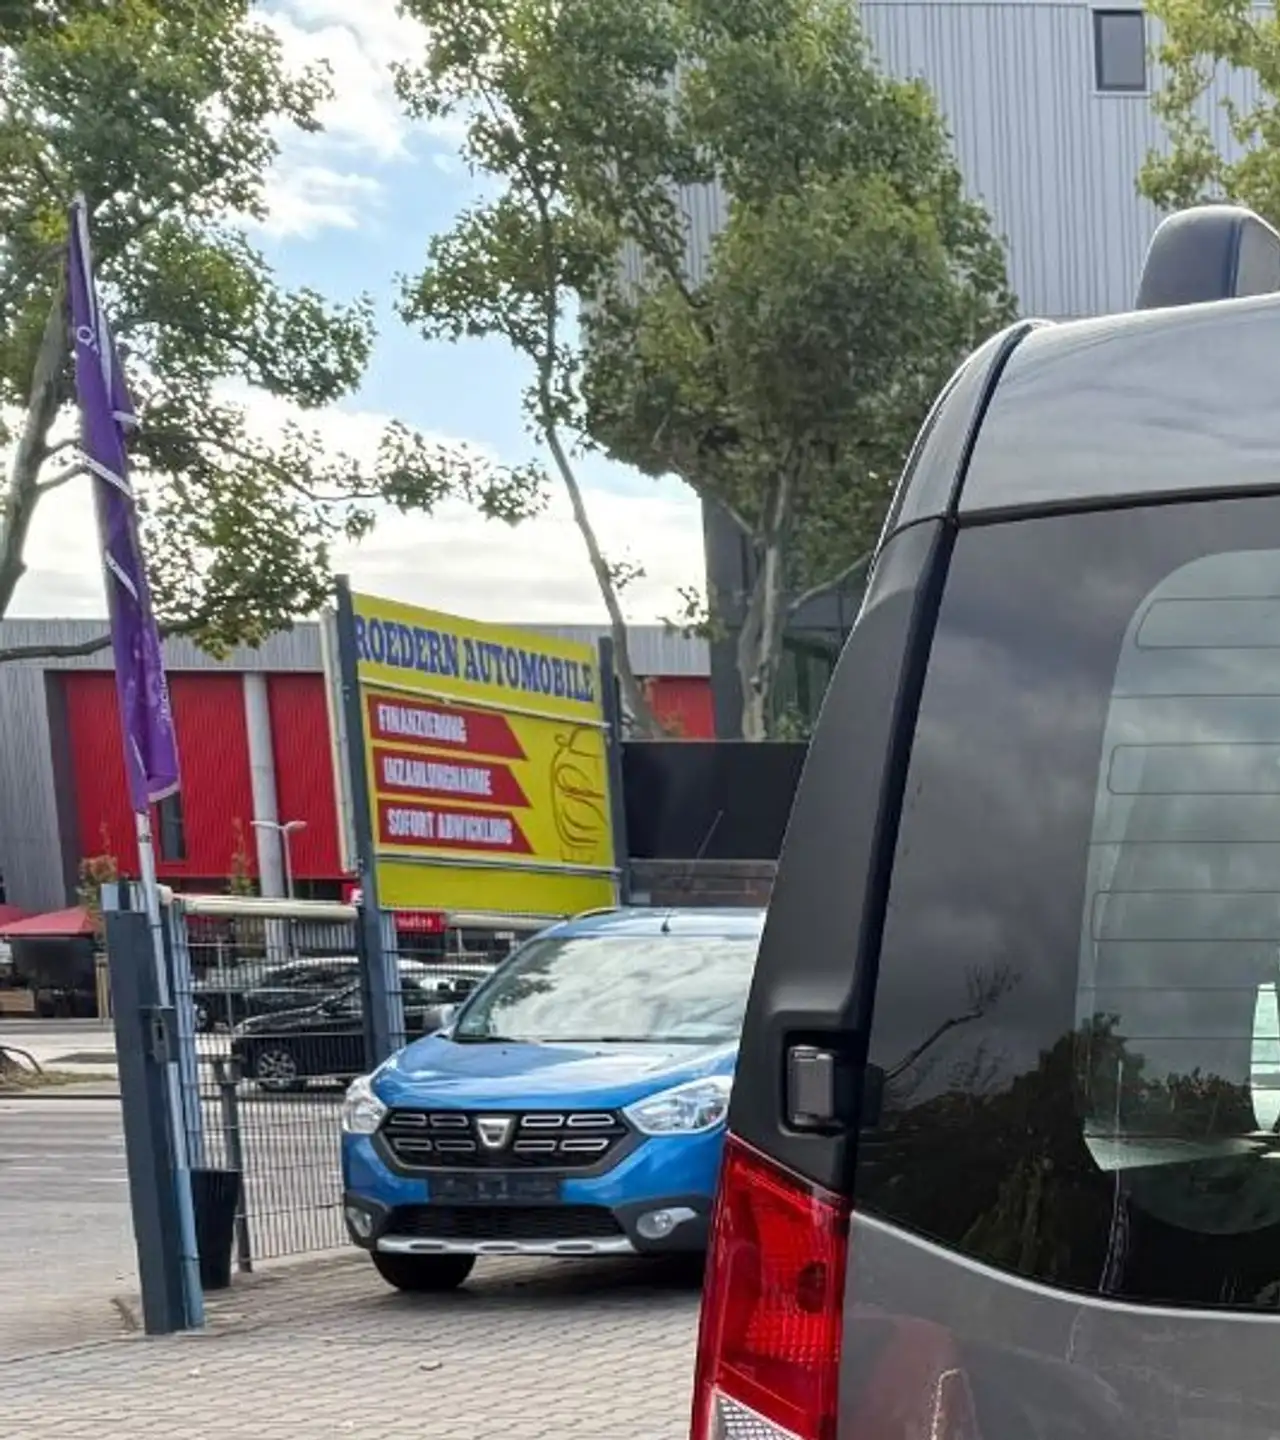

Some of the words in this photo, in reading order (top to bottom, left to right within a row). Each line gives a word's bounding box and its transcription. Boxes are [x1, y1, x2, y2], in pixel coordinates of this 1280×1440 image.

[354, 614, 459, 677] ROEDERN
[463, 639, 594, 702] AUTOMOBILE
[387, 807, 434, 839] SOFORT
